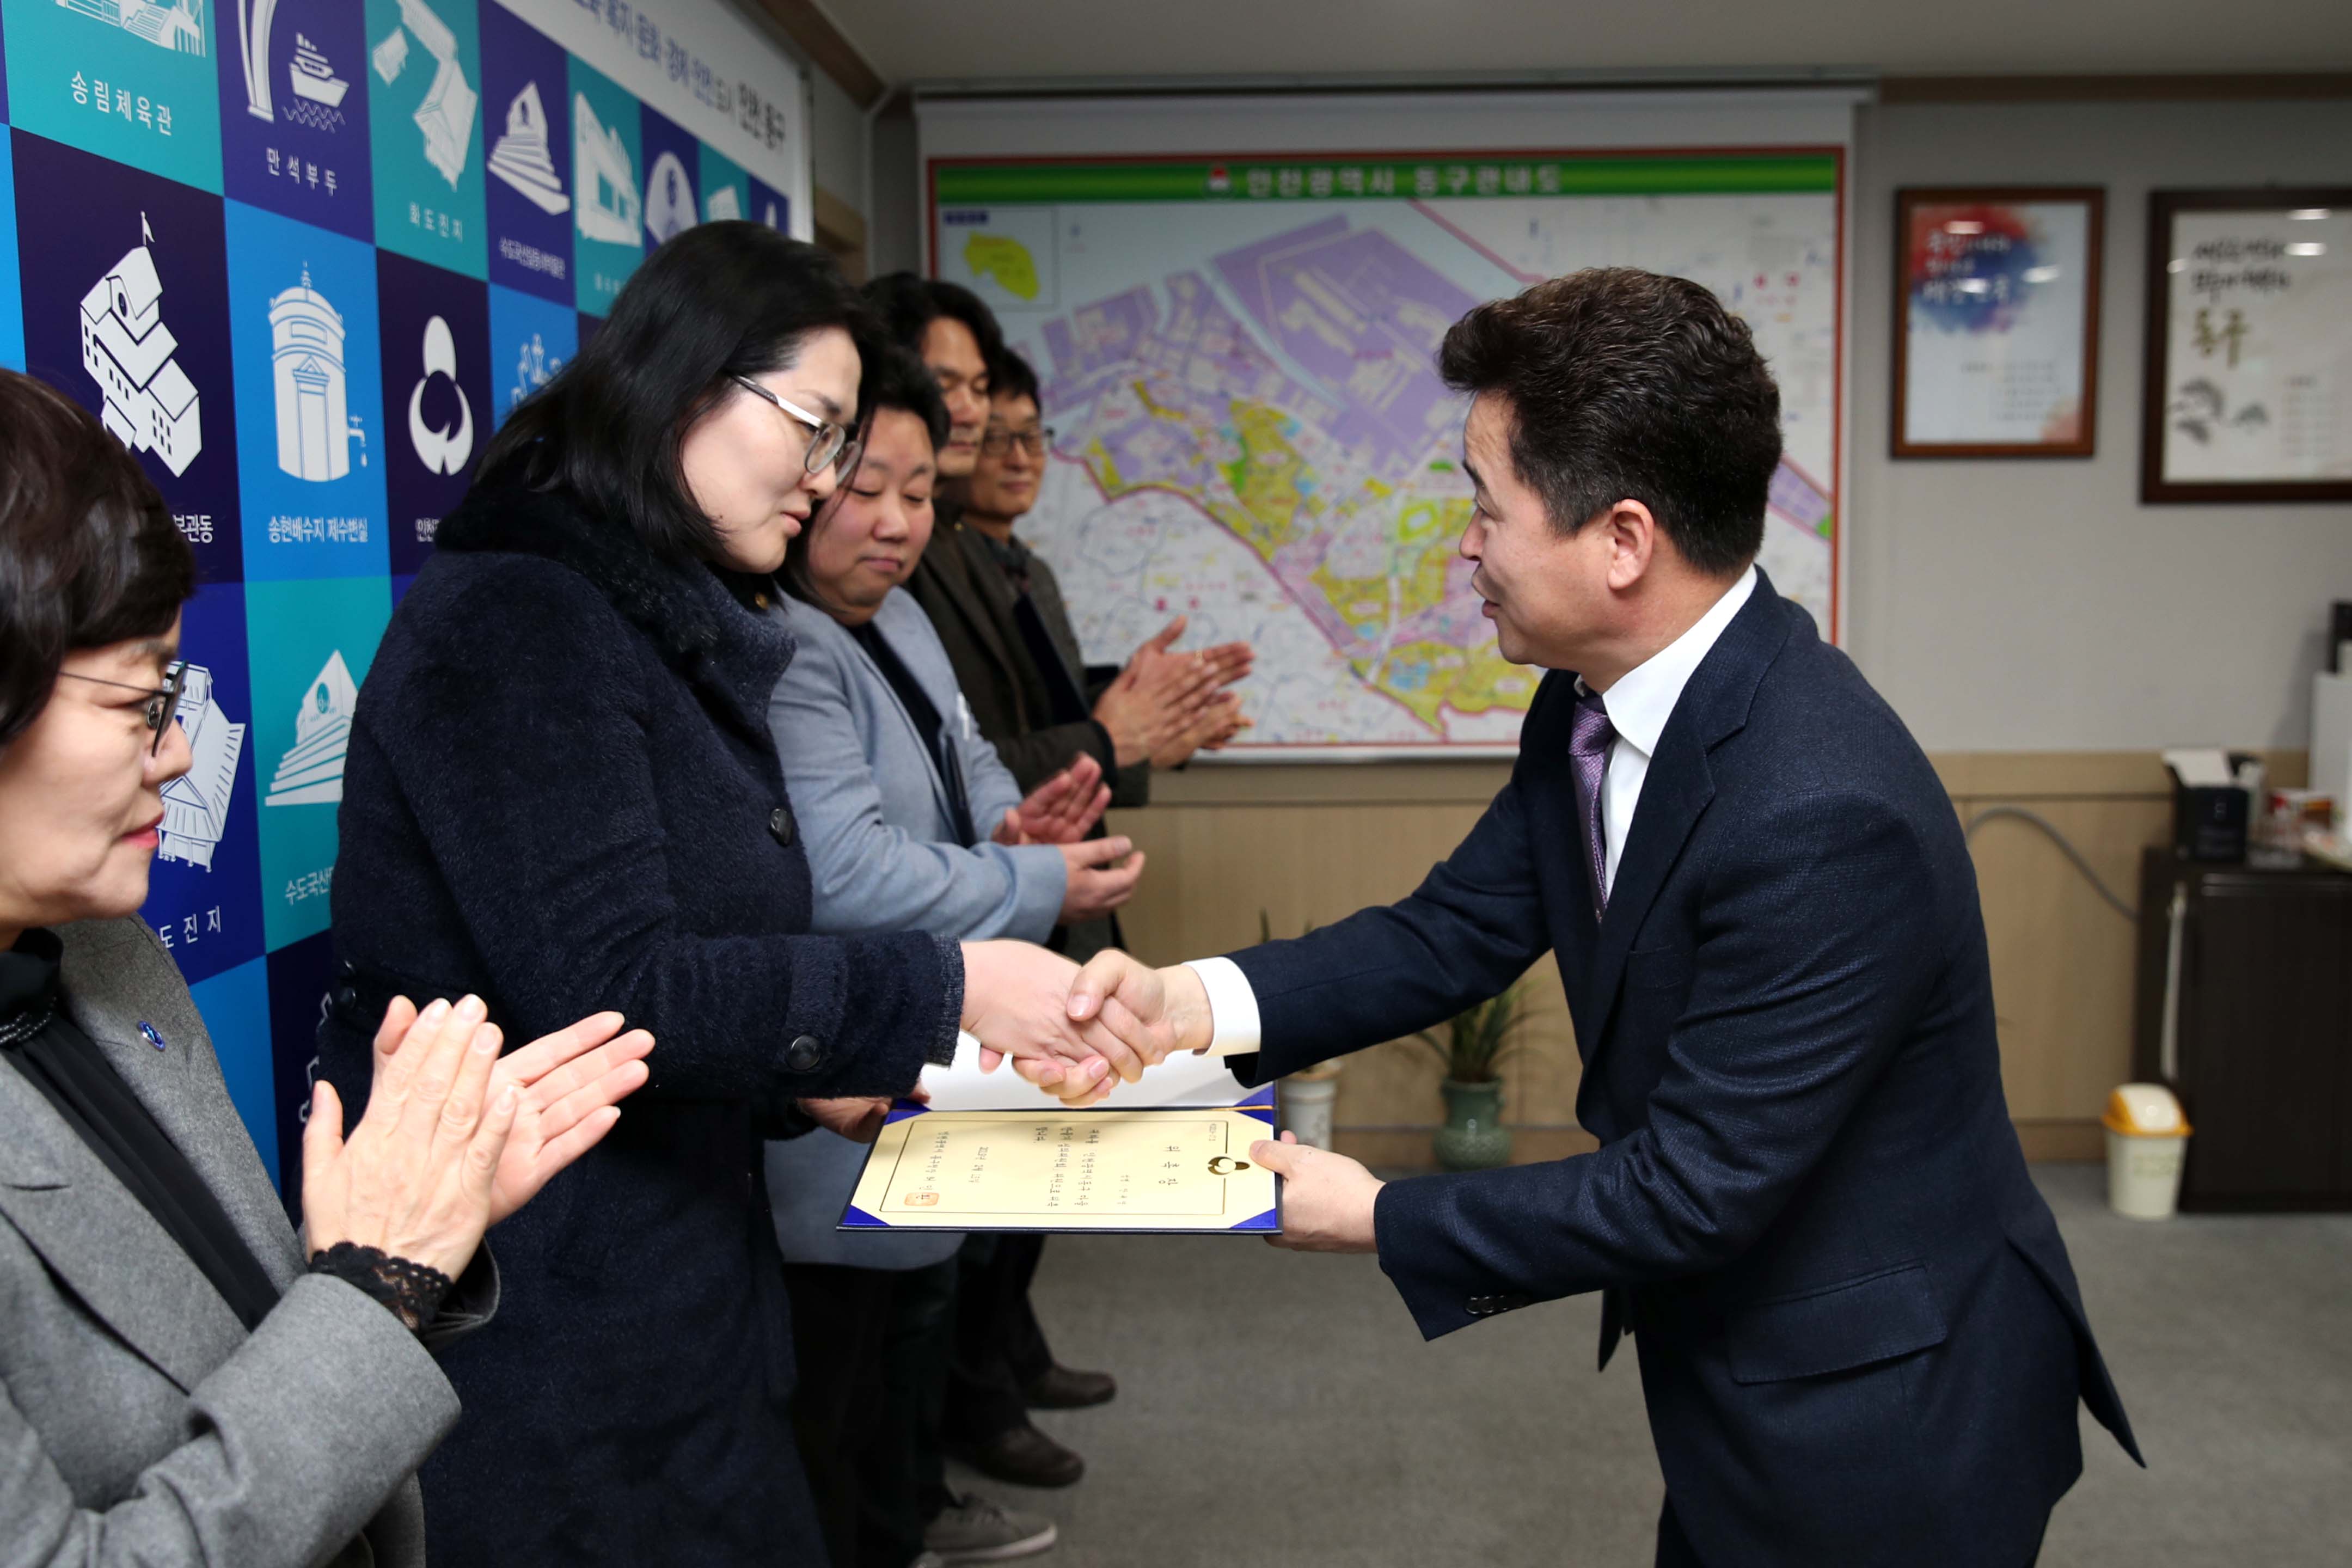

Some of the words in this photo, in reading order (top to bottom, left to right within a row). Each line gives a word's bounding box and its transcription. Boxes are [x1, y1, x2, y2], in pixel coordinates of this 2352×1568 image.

[71, 71, 172, 136] 송림체육관
[266, 147, 338, 197] 만석부두
[1246, 167, 1396, 198] 인천광역시
[409, 201, 463, 244] 화도진지
[268, 516, 324, 543] 송현배수지
